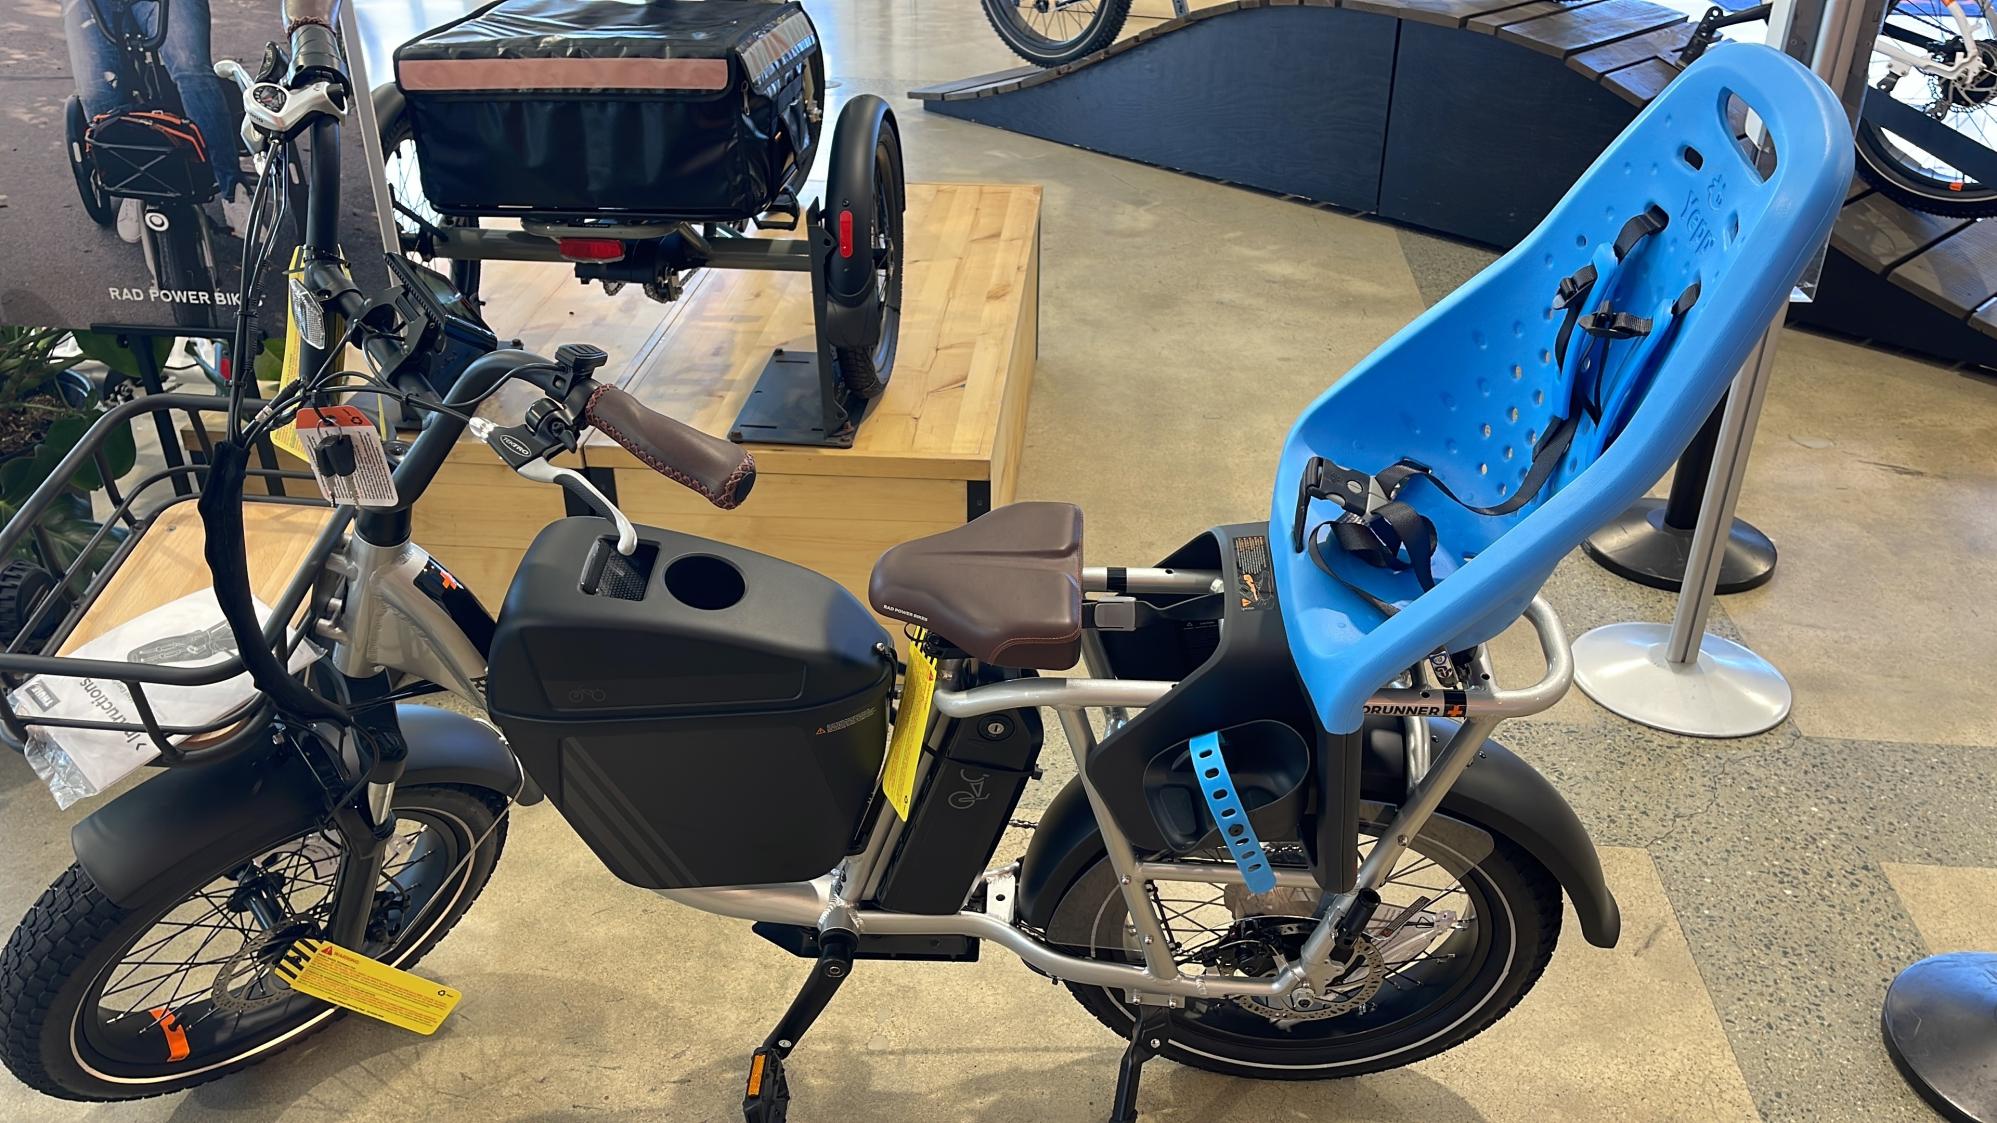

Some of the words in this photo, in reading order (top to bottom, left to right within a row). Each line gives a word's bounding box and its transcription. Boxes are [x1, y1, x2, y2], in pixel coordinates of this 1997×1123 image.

[108, 287, 144, 301] RAD
[149, 289, 211, 305] POWER
[503, 437, 529, 455] TEKTRO
[894, 607, 914, 617] POWER
